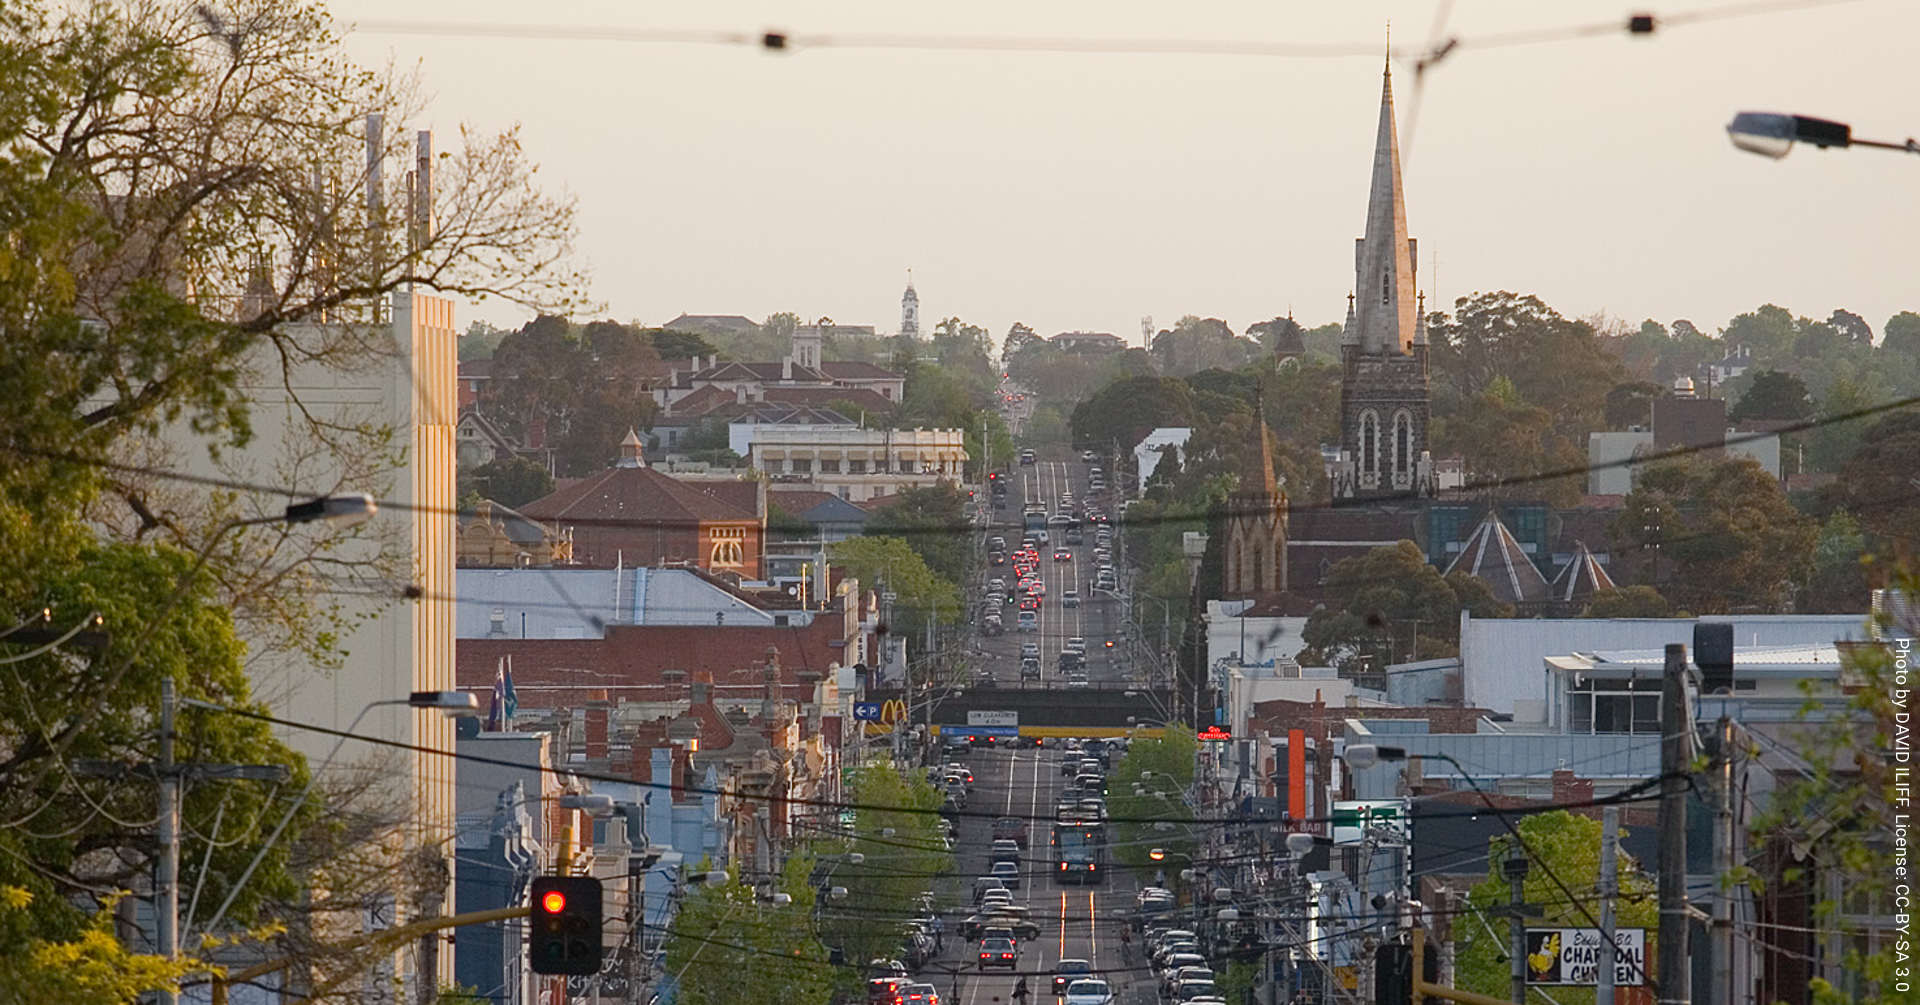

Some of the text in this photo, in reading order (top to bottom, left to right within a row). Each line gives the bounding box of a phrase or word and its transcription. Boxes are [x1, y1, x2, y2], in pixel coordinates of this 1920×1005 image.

[1270, 823, 1321, 833] MILK BAR
[1563, 946, 1642, 964] CHAROAL
